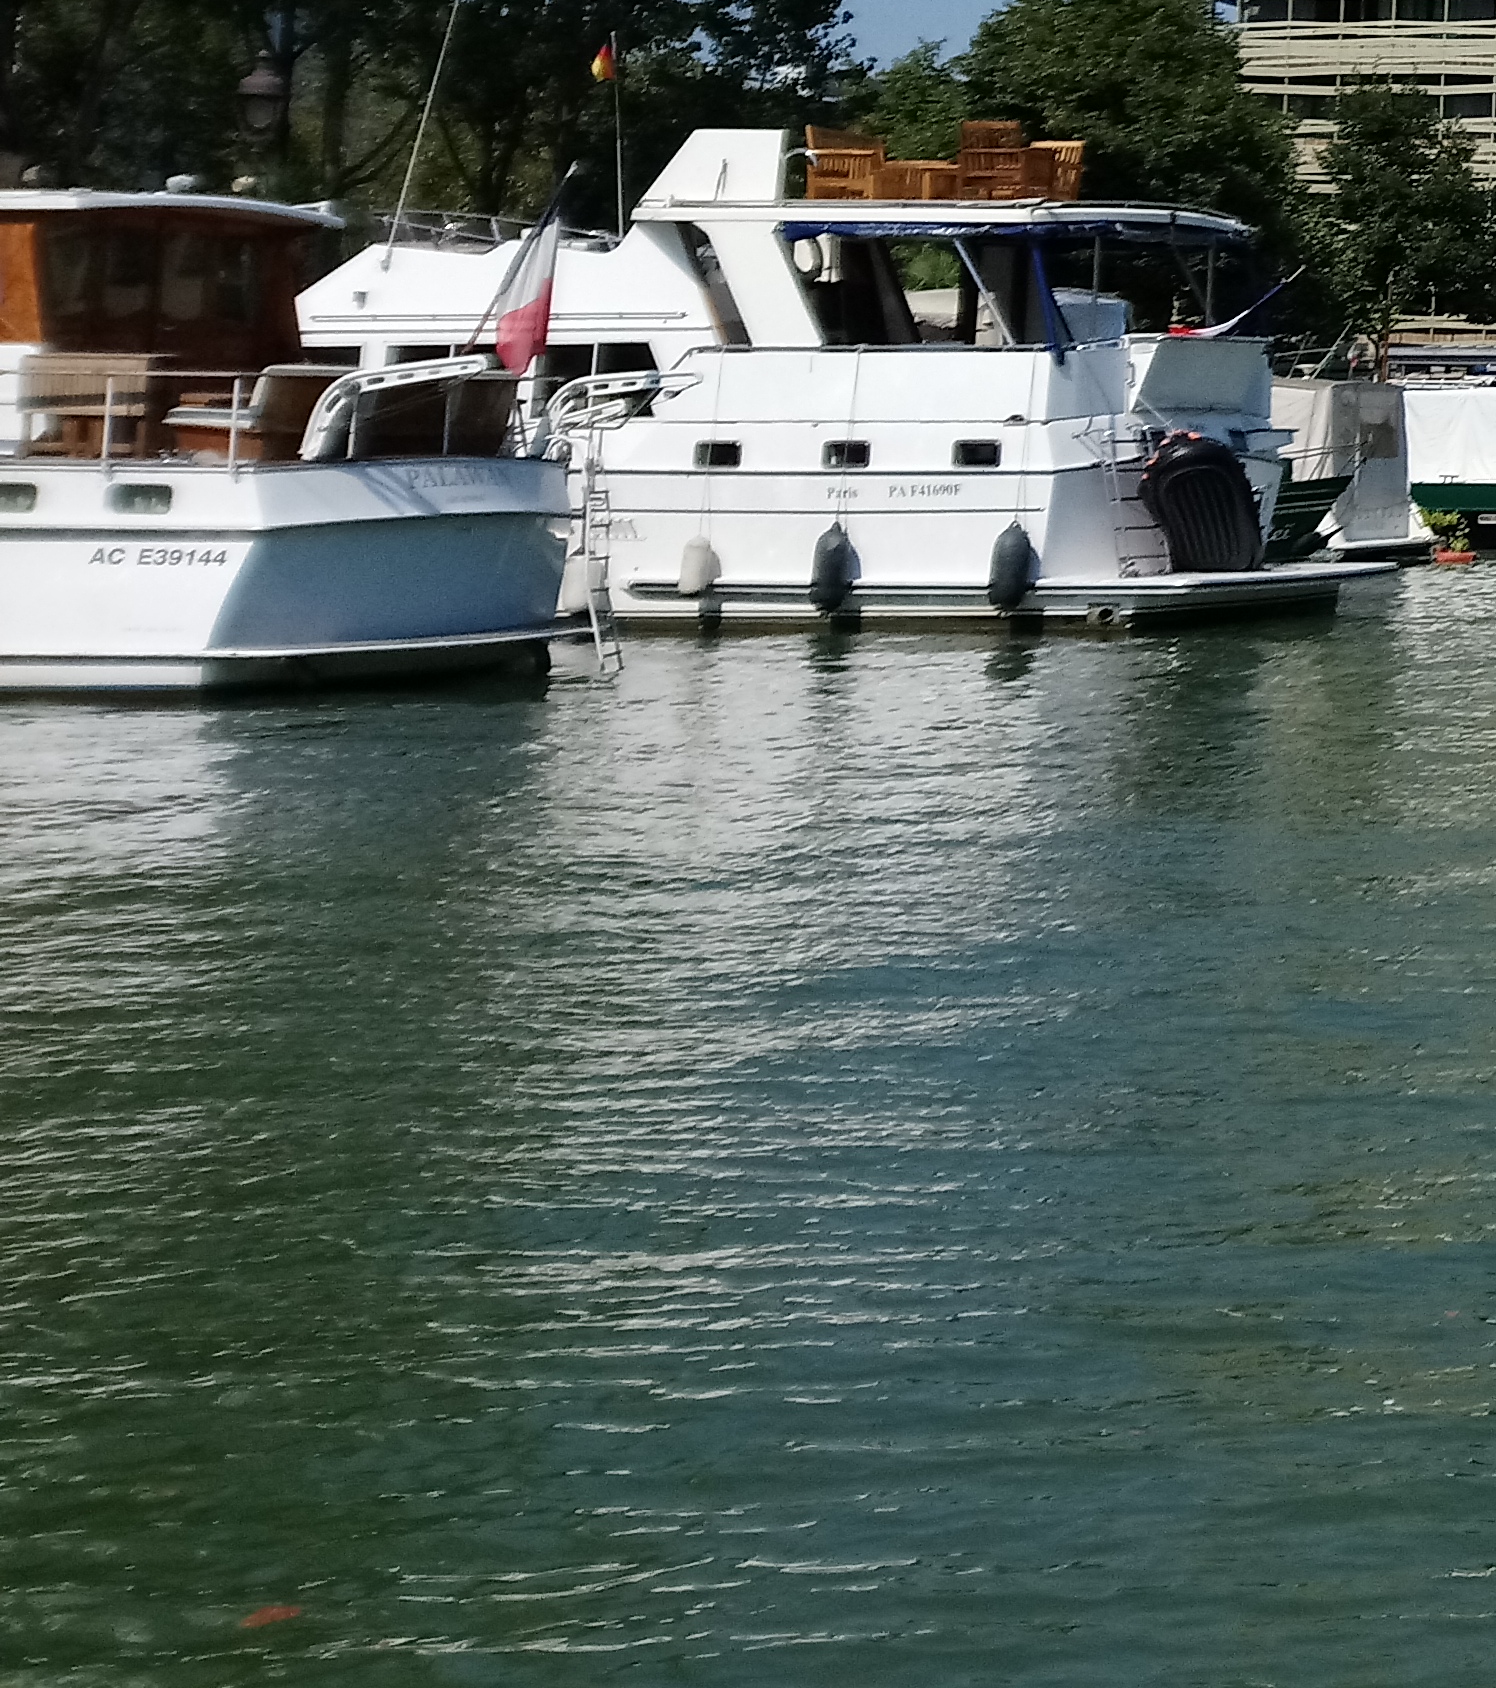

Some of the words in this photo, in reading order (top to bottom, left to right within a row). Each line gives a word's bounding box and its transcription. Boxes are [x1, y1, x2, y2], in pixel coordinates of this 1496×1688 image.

[888, 485, 906, 498] PA
[88, 547, 126, 565] AC
[136, 548, 228, 566] E39144
